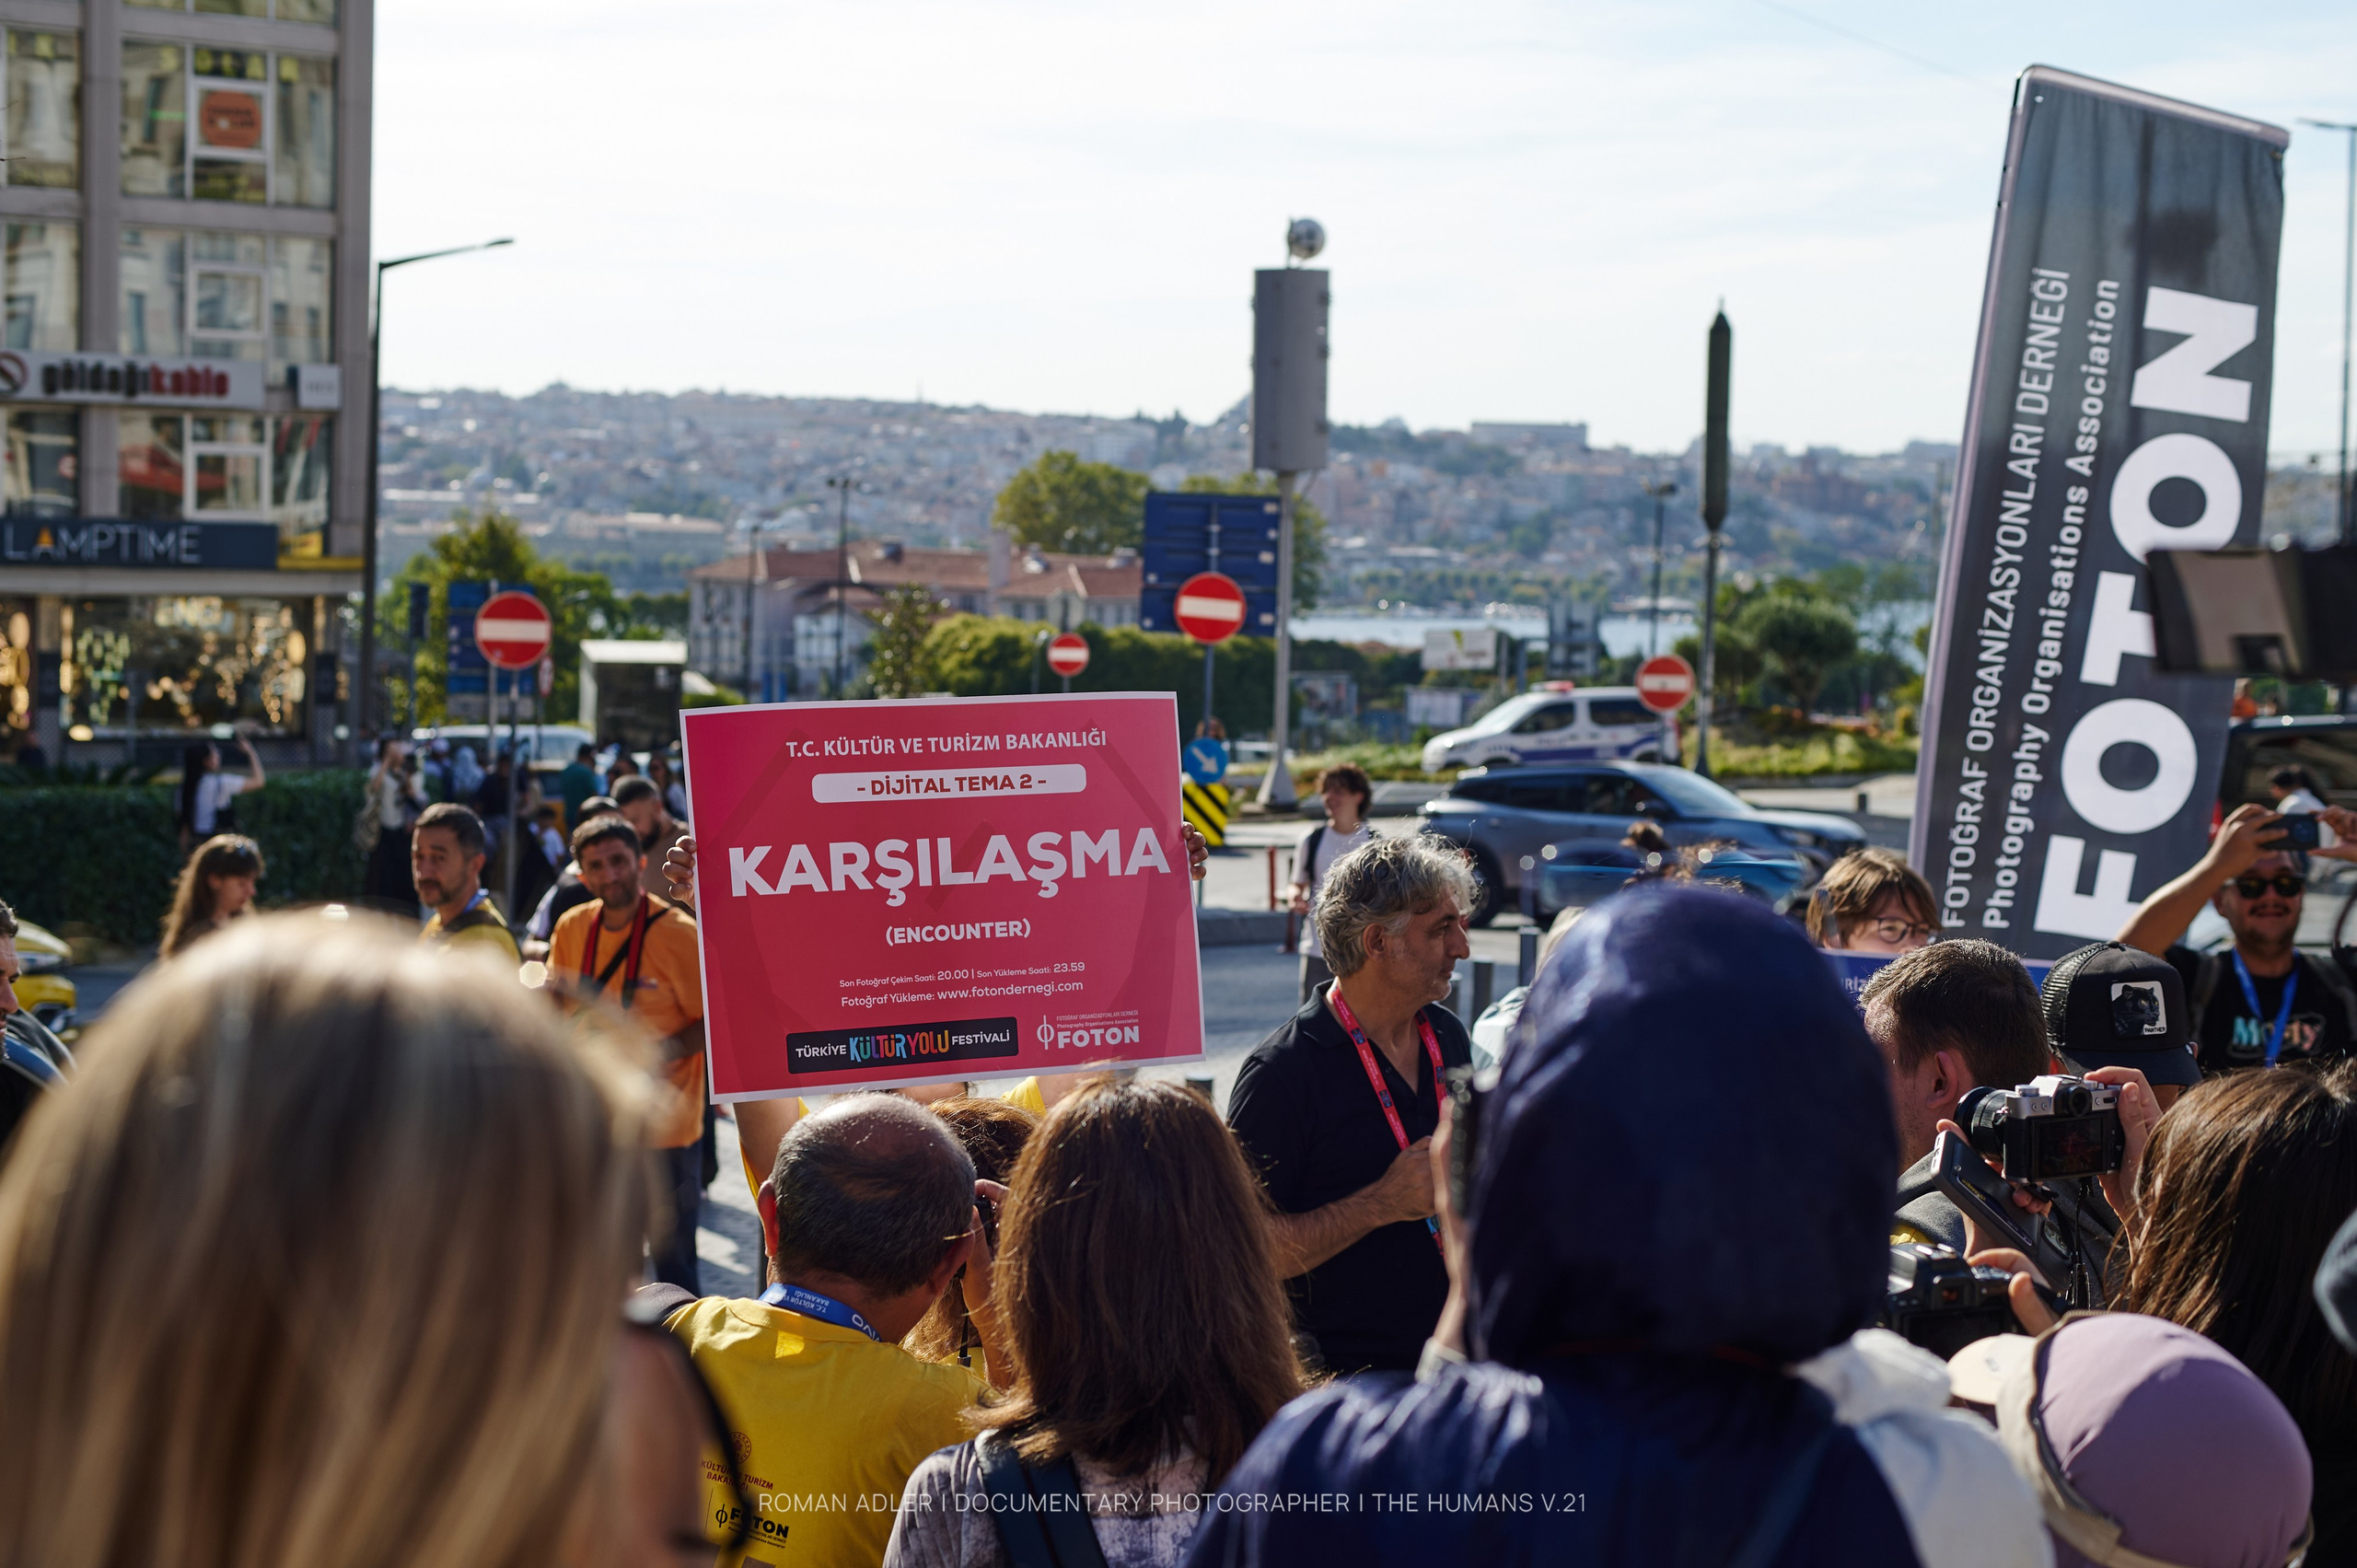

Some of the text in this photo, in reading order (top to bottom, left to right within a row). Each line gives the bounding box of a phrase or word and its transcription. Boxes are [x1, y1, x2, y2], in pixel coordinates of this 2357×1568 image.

[3, 523, 203, 564] LAMPTIME
[1942, 268, 2071, 928] FOTOĞRAF ORGANİZASYONLARI DERNEĞİ
[1982, 278, 2120, 929] Photography Organisations Association
[2033, 285, 2259, 943] FOTON
[785, 727, 1107, 758] T.C. KÜLTÜR VE TURİZM BAKANLIĞI
[871, 774, 951, 796] DİJİTAL
[955, 774, 1016, 793] TEMA
[1019, 773, 1032, 789] 2
[728, 827, 1172, 908] KARŞILAŞMA
[885, 918, 1031, 947] (ENCOUNTER)
[839, 979, 855, 988] Son
[855, 977, 889, 988] Fotoğraf
[890, 975, 913, 986] Çekim
[914, 973, 936, 982] Saati:
[937, 970, 970, 981] 20.00
[977, 970, 993, 979] Son
[993, 969, 1027, 977] Yükleme
[1028, 966, 1051, 975] Saati:
[1053, 961, 1086, 973] 23.59
[841, 981, 1084, 1009] Fotoğraf Yükleme: www.fotondernegi.com
[795, 1042, 847, 1058] TÜRKİYE
[951, 1028, 1011, 1046] FESTİVALİ
[1057, 1026, 1140, 1049] FOTON
[706, 1471, 749, 1493] BAKANĞI
[744, 1473, 774, 1491] TURİZM
[730, 1506, 790, 1539] FTON
